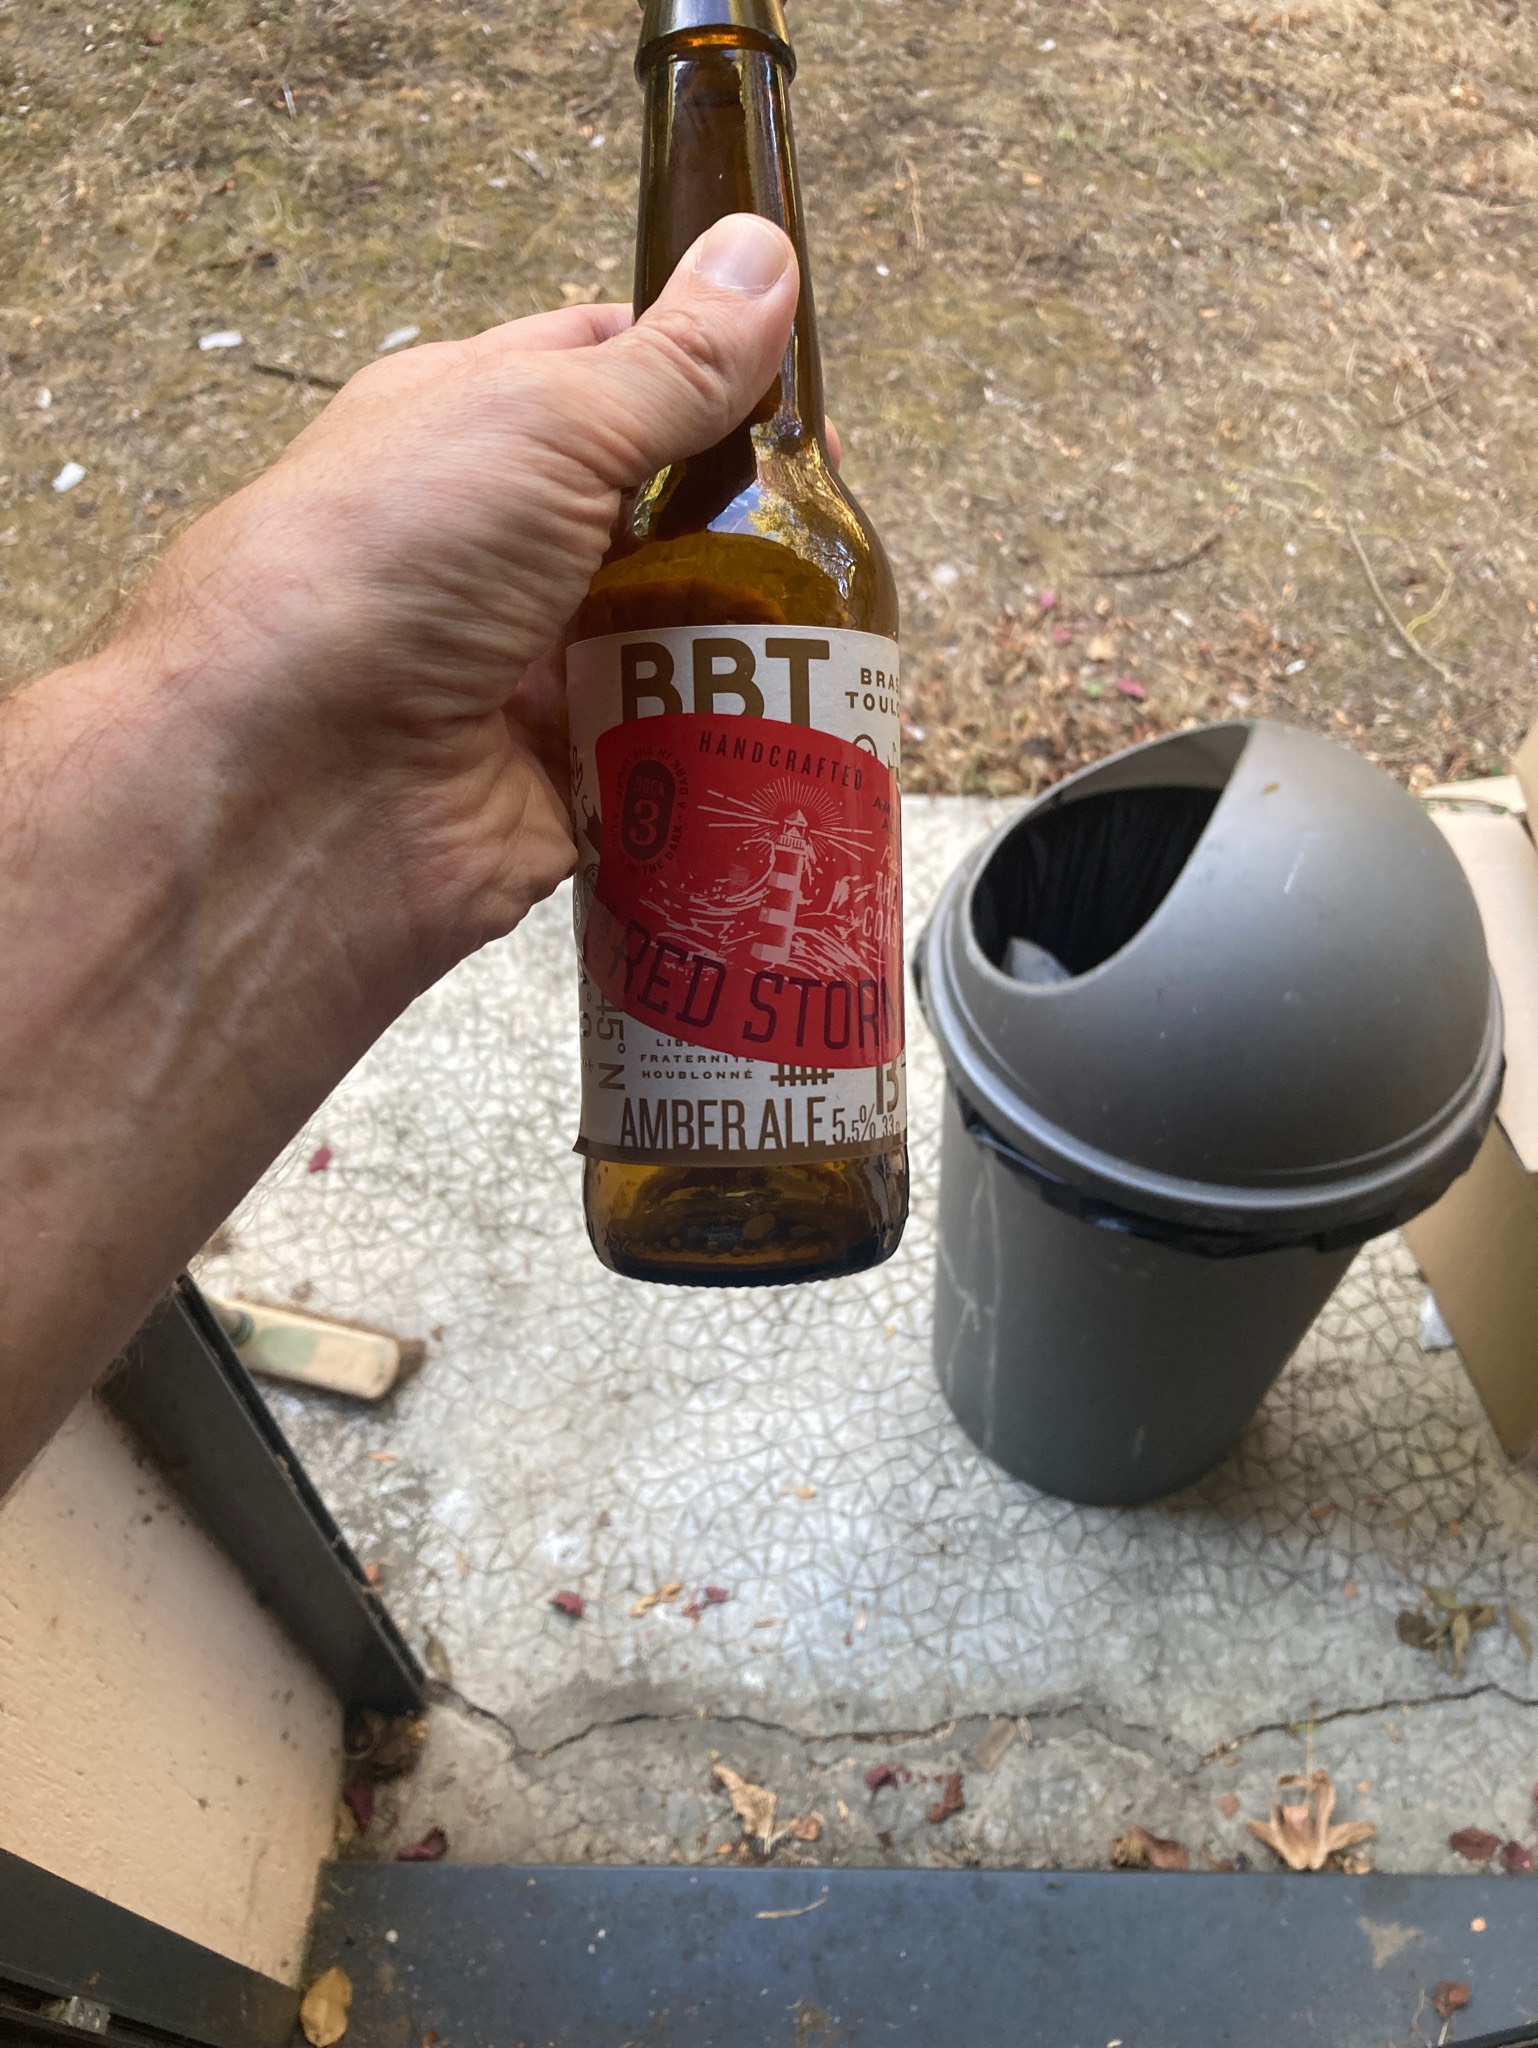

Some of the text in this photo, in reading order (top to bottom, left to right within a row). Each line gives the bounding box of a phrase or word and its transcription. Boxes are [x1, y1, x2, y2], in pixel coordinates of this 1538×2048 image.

[620, 636, 831, 730] BBT
[698, 729, 863, 791] HANDCRAFTED
[629, 799, 661, 846] 3
[607, 919, 727, 1028] RED
[599, 1062, 626, 1091] N
[642, 1068, 753, 1080] HOUBLONNÉ
[620, 1097, 748, 1150] AMBER
[758, 1096, 829, 1150] ALE
[832, 1103, 877, 1145] 5.5%
